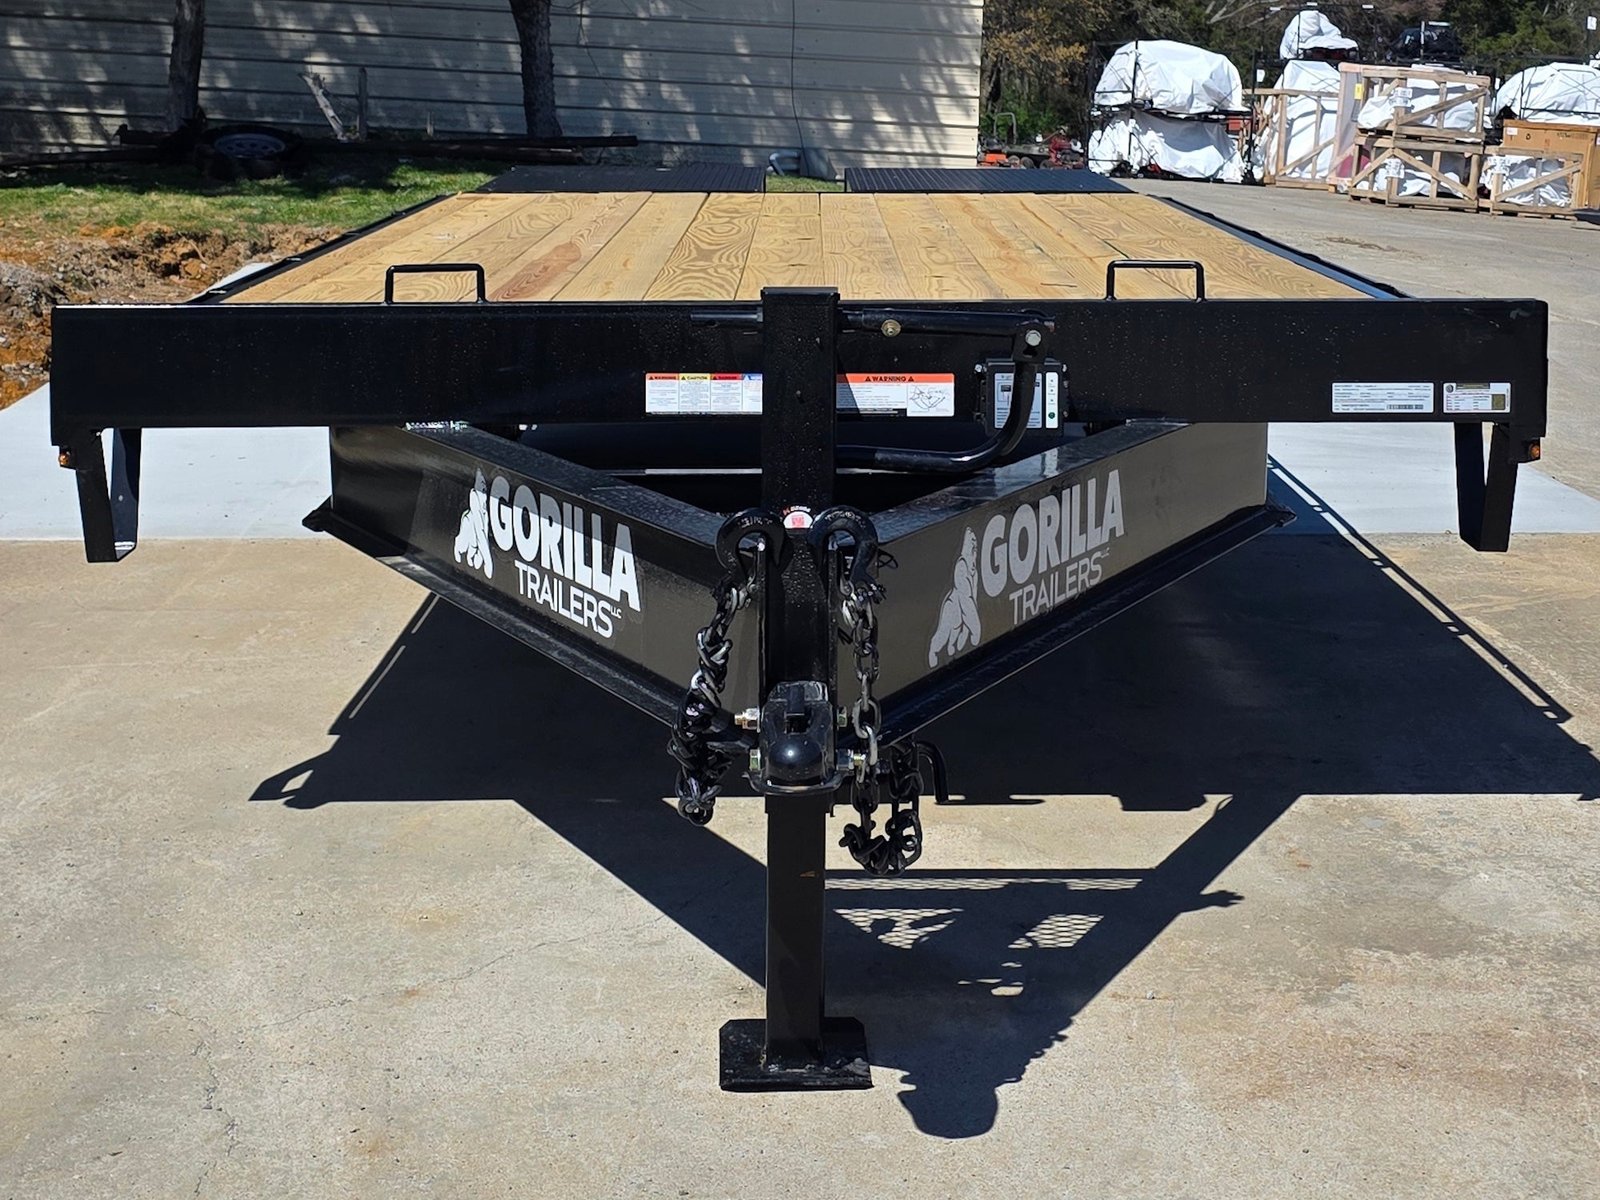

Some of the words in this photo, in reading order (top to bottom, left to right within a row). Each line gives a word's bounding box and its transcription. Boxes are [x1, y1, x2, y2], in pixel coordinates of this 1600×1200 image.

[489, 475, 641, 612] GORILLA
[981, 469, 1124, 598] GORILLA
[514, 559, 613, 639] TRAILERS
[1009, 551, 1102, 625] TRAILERS
